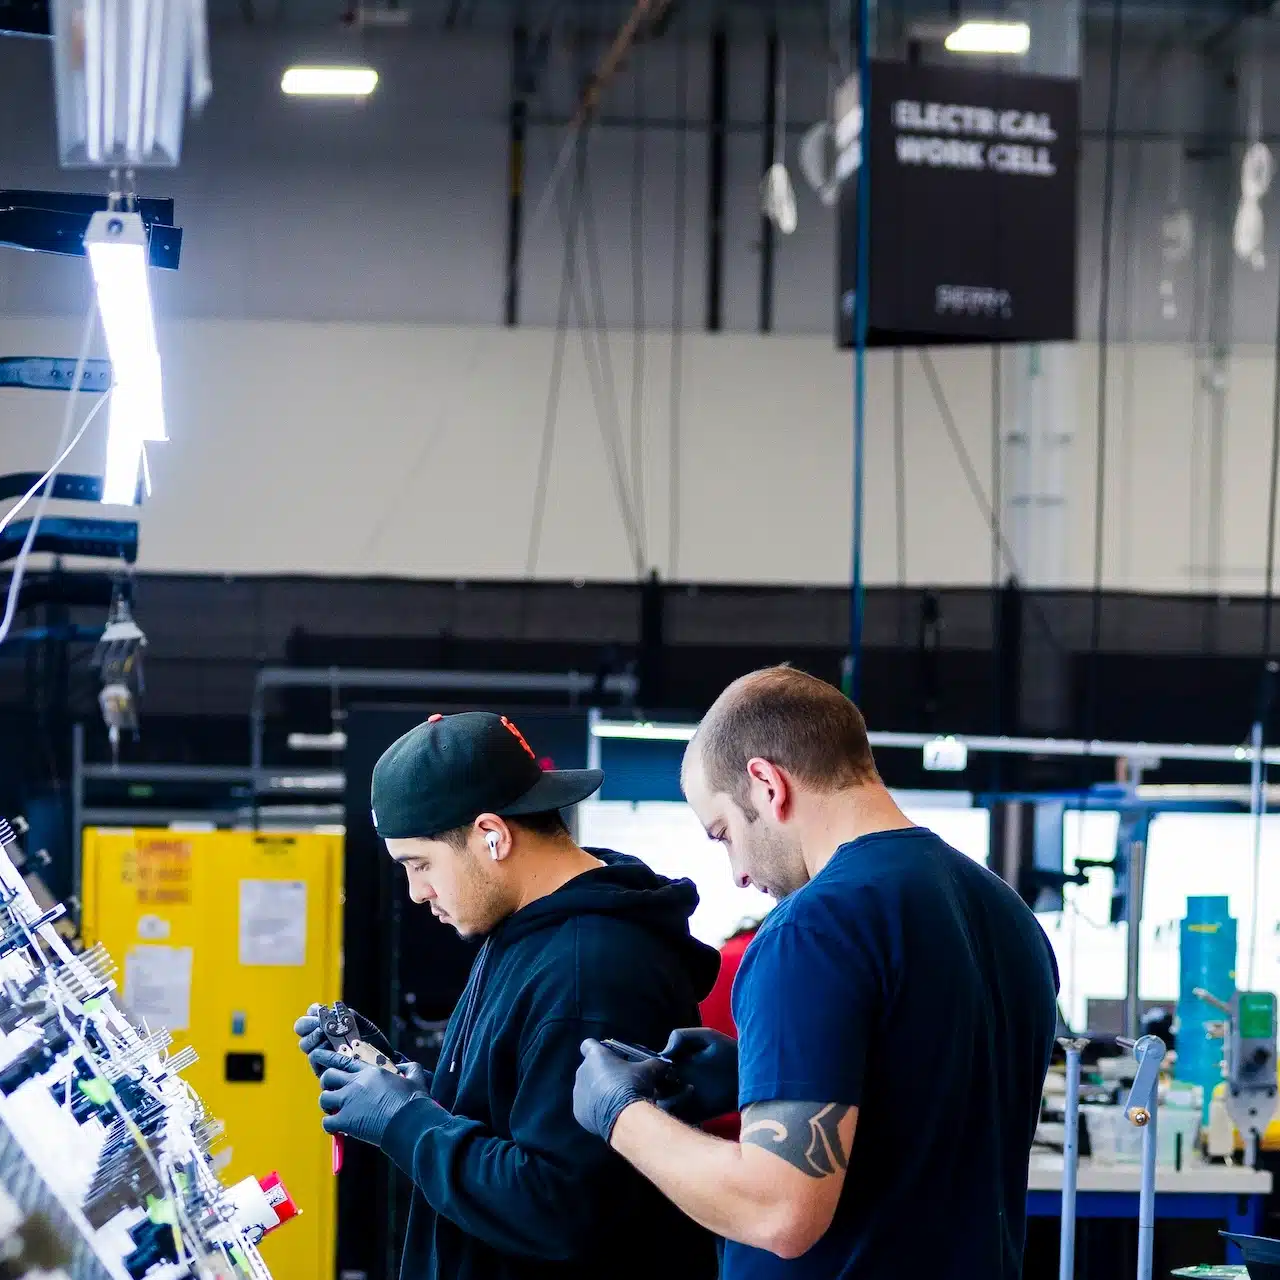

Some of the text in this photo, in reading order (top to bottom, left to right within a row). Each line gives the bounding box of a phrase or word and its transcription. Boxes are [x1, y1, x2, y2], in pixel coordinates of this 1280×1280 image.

[893, 100, 1056, 141] ELECTRICAL
[894, 136, 1056, 175] WORK CELL
